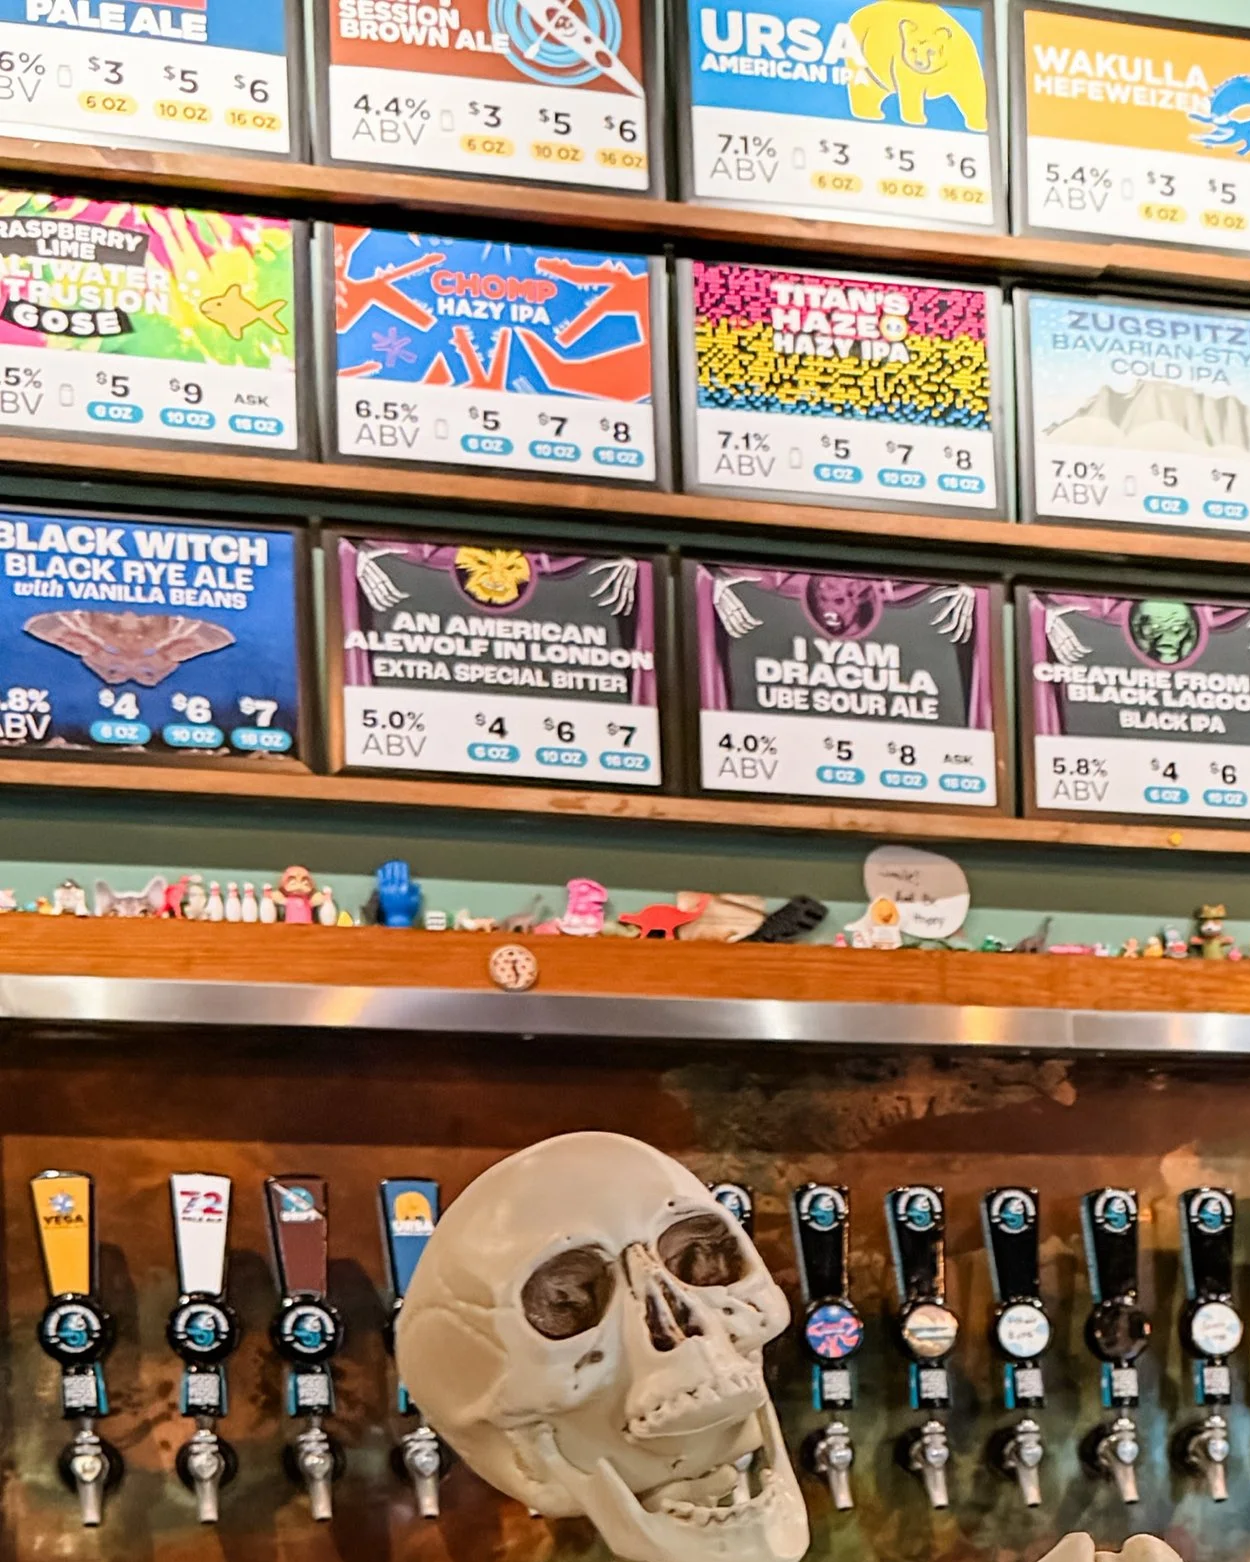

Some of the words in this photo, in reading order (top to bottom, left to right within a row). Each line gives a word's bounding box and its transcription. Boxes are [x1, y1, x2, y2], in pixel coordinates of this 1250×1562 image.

[26, 0, 125, 31] PALE
[130, 6, 207, 41] ALE
[339, 0, 460, 29] SESSION
[339, 18, 449, 48] BROWN
[455, 30, 509, 55] ALE
[700, 8, 867, 68] URSA
[88, 56, 123, 85] $3
[164, 65, 198, 93] $5
[234, 74, 269, 104] $6
[700, 54, 828, 84] AMERICAN
[832, 64, 869, 86] IPA
[1033, 44, 1208, 92] WAKULLA
[103, 98, 127, 112] OZ
[1033, 74, 1210, 115] HEFEWEIZEN
[160, 103, 177, 117] 10
[184, 106, 207, 121] OZ
[253, 115, 276, 130] OZ
[354, 94, 430, 121] 4.4%
[469, 101, 501, 128] $3
[539, 108, 571, 135] $5
[604, 115, 637, 143] $6
[352, 118, 424, 146] ABV
[718, 134, 777, 157] 7.1%
[710, 157, 779, 184] ABV
[1046, 163, 1112, 189] 5.4%
[37, 239, 96, 261] LIME
[431, 269, 557, 303] CHOMP
[770, 281, 911, 317] TITAN'S
[13, 302, 122, 335] GOSE
[437, 297, 504, 321] HAZY
[511, 304, 551, 326] IPA
[771, 306, 882, 340] HAZE
[773, 333, 857, 359] HAZY
[861, 339, 911, 364] IPA
[1112, 359, 1182, 381] COLD
[1190, 365, 1231, 386] IPA
[97, 371, 130, 398] $5
[169, 378, 203, 405] $9
[234, 393, 269, 408] ASK
[356, 399, 419, 423] 6.5%
[718, 430, 770, 452] 7.1%
[1051, 460, 1106, 482] 7.0%
[0, 520, 126, 558] BLACK
[133, 530, 269, 567] WITCH
[5, 552, 117, 583] BLACK
[123, 560, 187, 587] RYE
[194, 565, 255, 592] ALE
[13, 580, 64, 599] with
[69, 581, 166, 605] VANILLA
[169, 588, 248, 611] BEANS
[392, 612, 441, 634] AN
[446, 615, 607, 646] AMERICAN
[344, 630, 488, 658] ALEWOLF
[494, 642, 526, 661] IN
[531, 644, 655, 670] LONDON
[793, 636, 807, 661] I
[813, 638, 900, 668] YAM
[373, 658, 452, 682] EXTRA
[454, 663, 549, 689] SPECIAL
[552, 671, 628, 694] BITTER
[755, 657, 939, 696] DRACULA
[1033, 662, 1172, 690] CREATURE
[1174, 671, 1250, 695] FROM
[99, 689, 140, 720] $4
[171, 693, 212, 724] $6
[239, 696, 278, 728] $7
[757, 685, 810, 710] UBE
[812, 691, 886, 717] SOUR
[889, 695, 939, 720] ALE
[1067, 684, 1160, 707] BLACK
[362, 708, 425, 733] 5.0%
[474, 711, 508, 738] $4
[543, 717, 575, 743] $6
[607, 723, 637, 749] $7
[1119, 710, 1189, 732] BLACK
[1191, 714, 1226, 734] IPA
[362, 733, 427, 758] ABV
[718, 733, 777, 755] 4.0%
[1052, 757, 1108, 778] 5.8%
[180, 1190, 223, 1214] 72
[43, 1214, 84, 1225] VEGA
